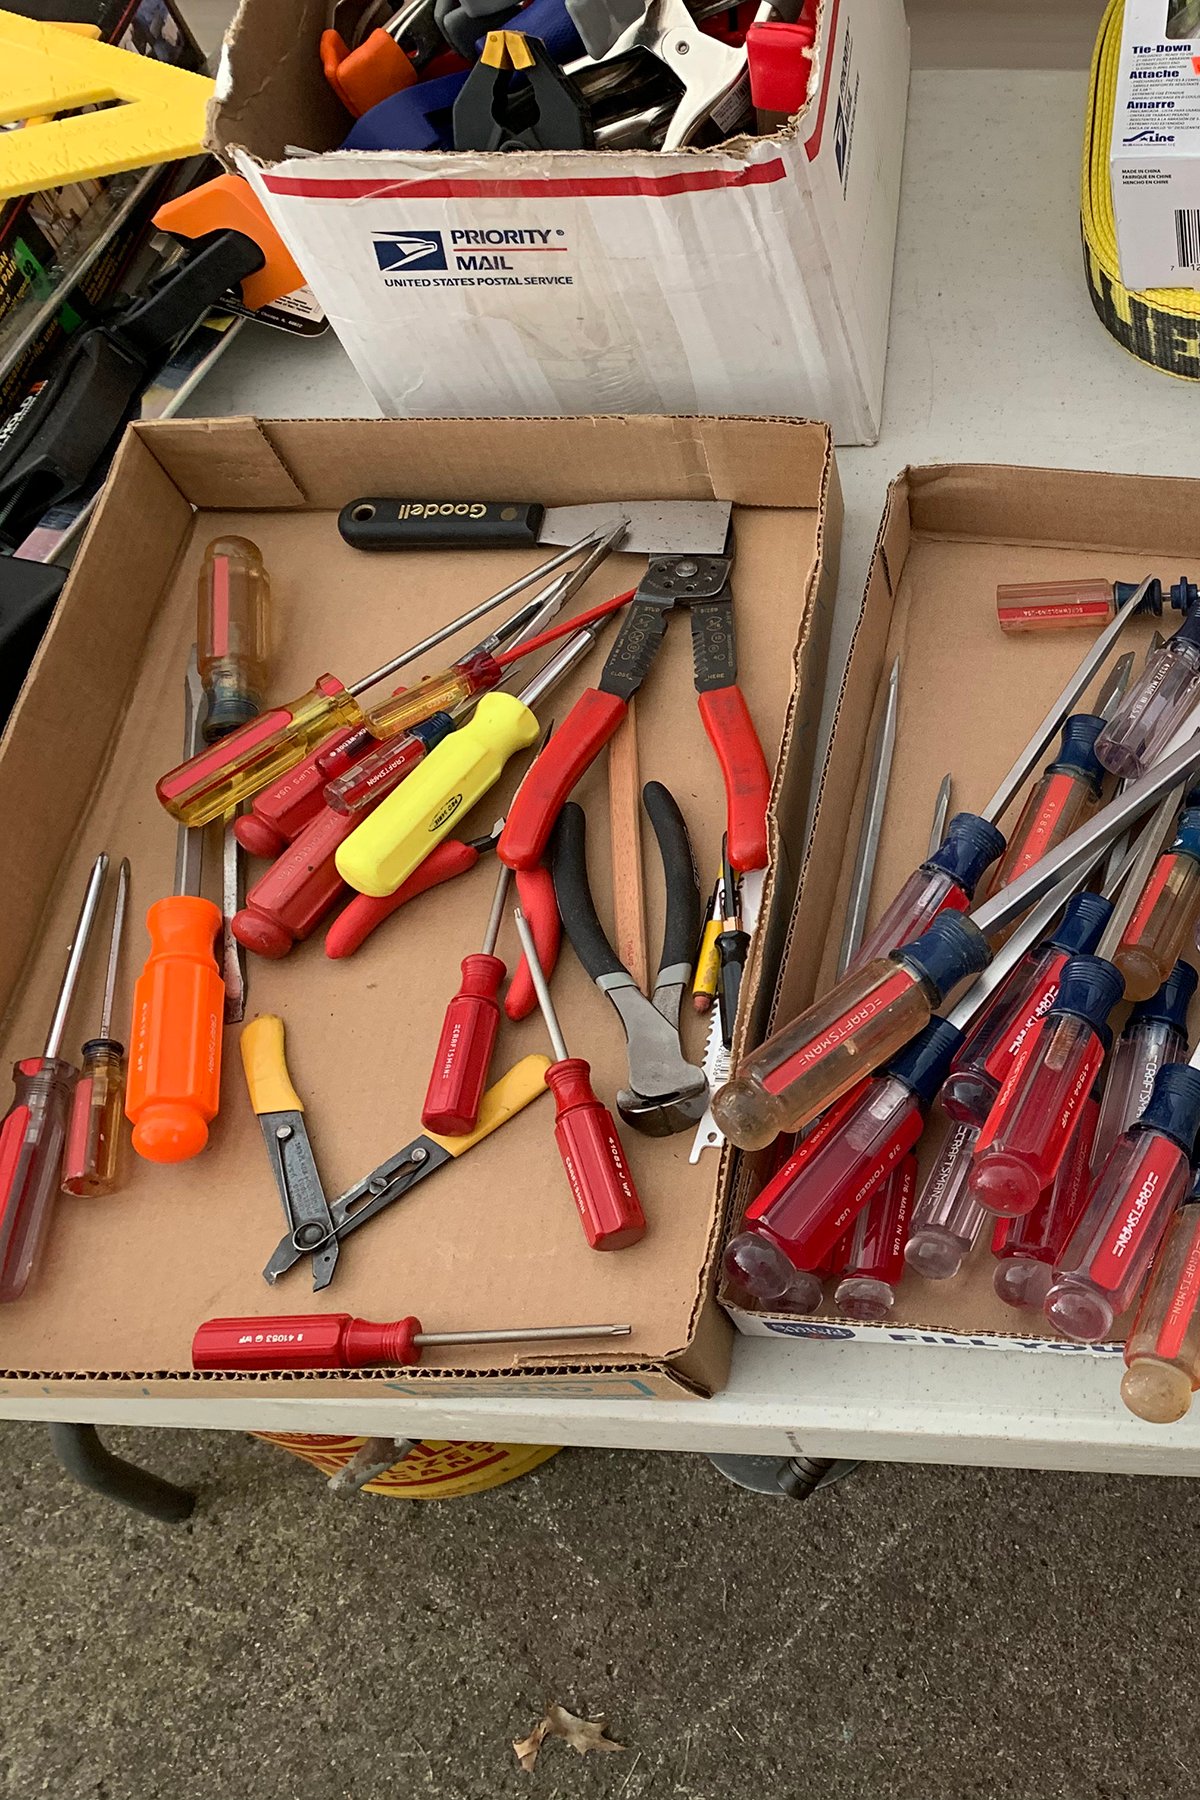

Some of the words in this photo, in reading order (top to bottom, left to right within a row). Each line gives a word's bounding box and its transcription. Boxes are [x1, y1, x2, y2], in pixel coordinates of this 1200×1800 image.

[1132, 44, 1191, 54] Tie-Down
[1129, 70, 1180, 79] Attache
[1126, 101, 1175, 109] Amarre
[451, 229, 551, 244] PRIORITY
[456, 256, 513, 270] MAIL
[384, 279, 431, 287] UNITED
[433, 278, 475, 286] STATES
[477, 277, 523, 285] POSTAL
[524, 276, 574, 285] SERVICE
[397, 503, 487, 520] Goodell
[367, 755, 406, 787] CRAFTSMAN
[275, 786, 291, 800] USA
[803, 998, 878, 1063] CRAFTSMAN
[207, 1013, 217, 1074] CRAFTSMAN
[443, 1025, 461, 1077] CRAFTSMAN
[1061, 1110, 1071, 1129] WF
[933, 1128, 966, 1203] CRAFTSMAN
[565, 1156, 586, 1214] CRAFTSMAN
[835, 1208, 850, 1227] USA
[897, 1195, 907, 1222] MADE
[1117, 1176, 1156, 1253] CRAFTSMAN
[896, 1223, 903, 1235] IN
[892, 1236, 900, 1257] USA
[1172, 1244, 1200, 1320] CRAFTSMAN
[266, 1334, 294, 1343] 41053
[889, 1334, 998, 1347] FILL
